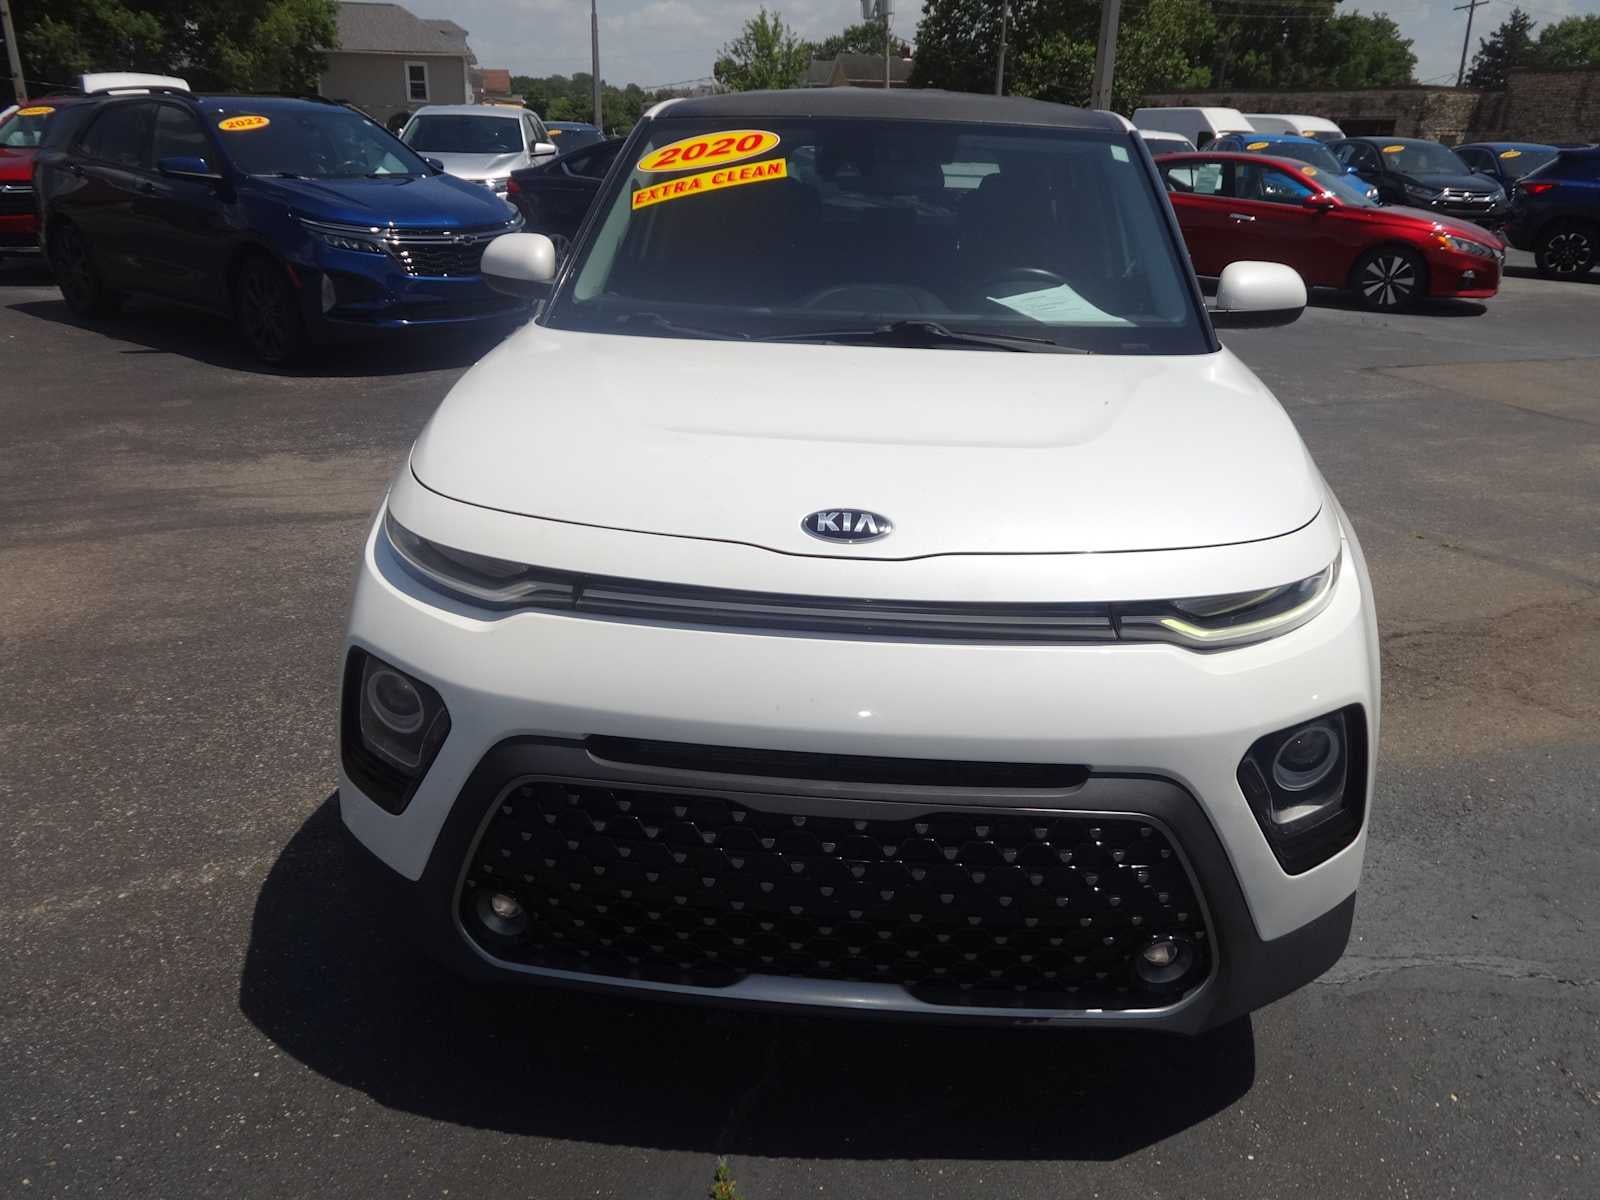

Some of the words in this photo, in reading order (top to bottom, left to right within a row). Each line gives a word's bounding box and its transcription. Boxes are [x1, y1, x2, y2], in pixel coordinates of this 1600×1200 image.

[225, 116, 263, 129] 2022
[651, 134, 764, 169] 2020
[634, 178, 702, 205] EXTRA
[711, 162, 782, 185] CLEAN
[816, 511, 879, 535] KIA
